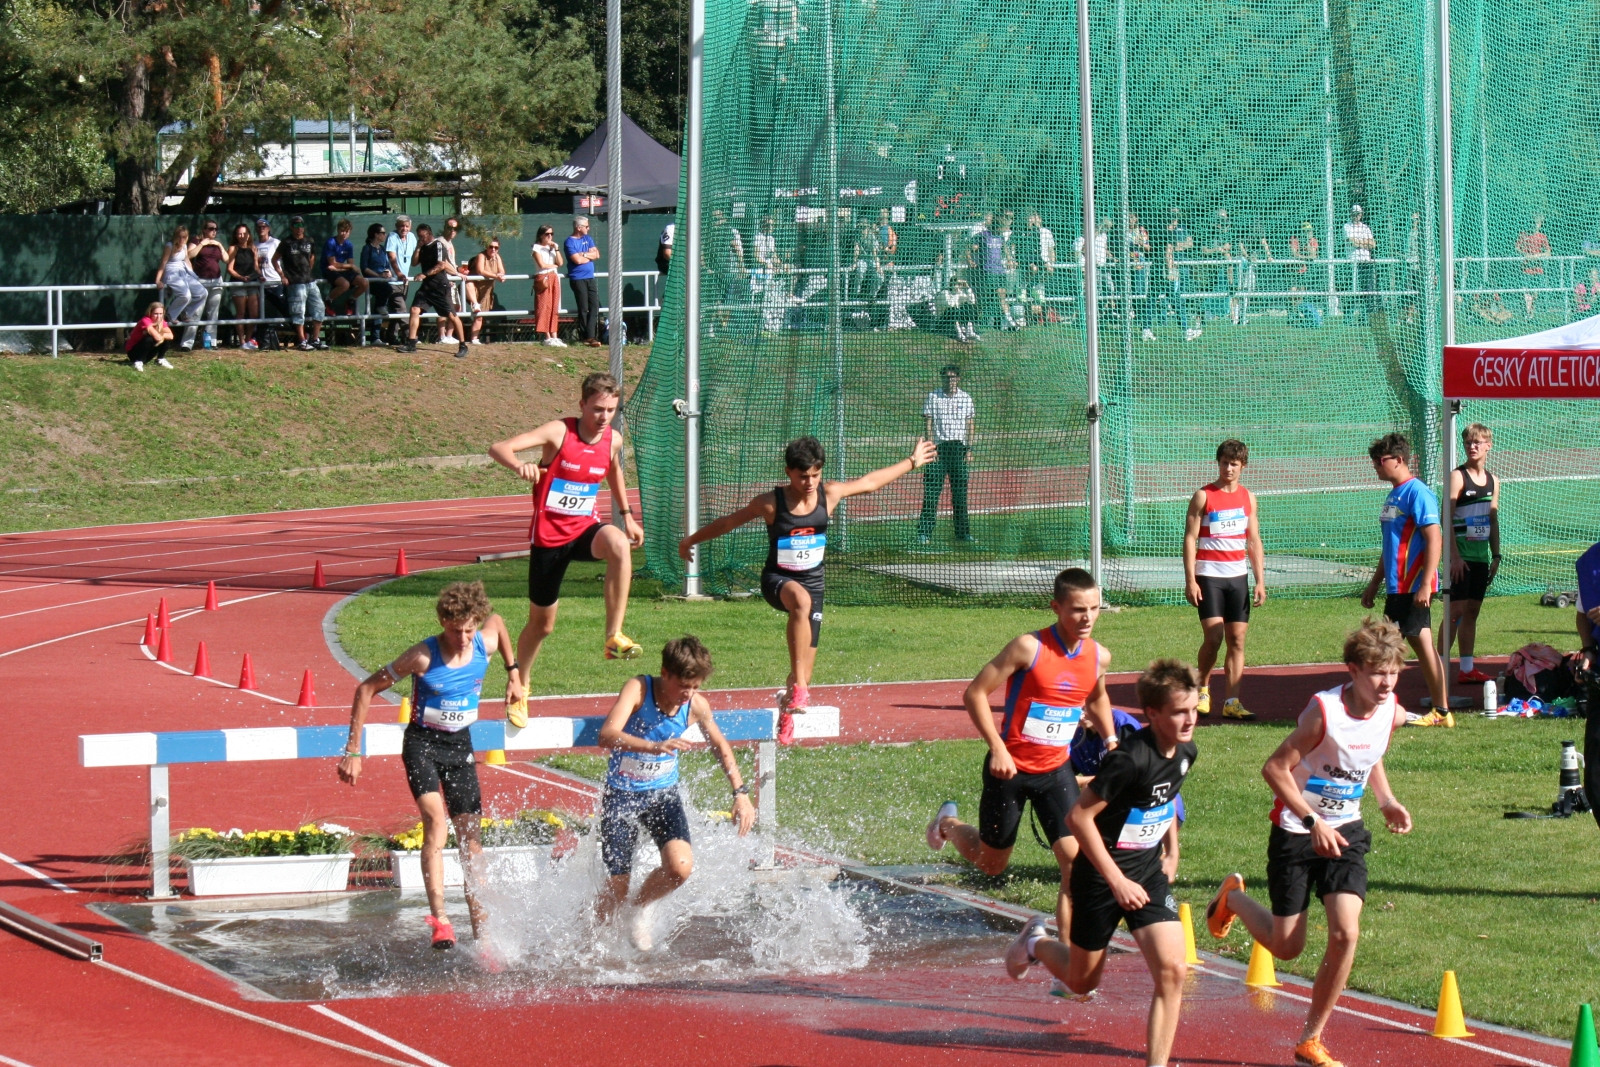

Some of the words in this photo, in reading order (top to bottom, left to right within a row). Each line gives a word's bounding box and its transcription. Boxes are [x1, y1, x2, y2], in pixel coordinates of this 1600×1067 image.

[1473, 350, 1527, 387] ČESKÝ
[558, 495, 587, 510] 497
[1220, 520, 1236, 529] 544
[796, 550, 810, 560] 45
[440, 711, 464, 722] 586
[1046, 723, 1061, 734] 61
[637, 761, 661, 772] 345
[1318, 797, 1346, 810] 525
[1139, 822, 1161, 837] 537
